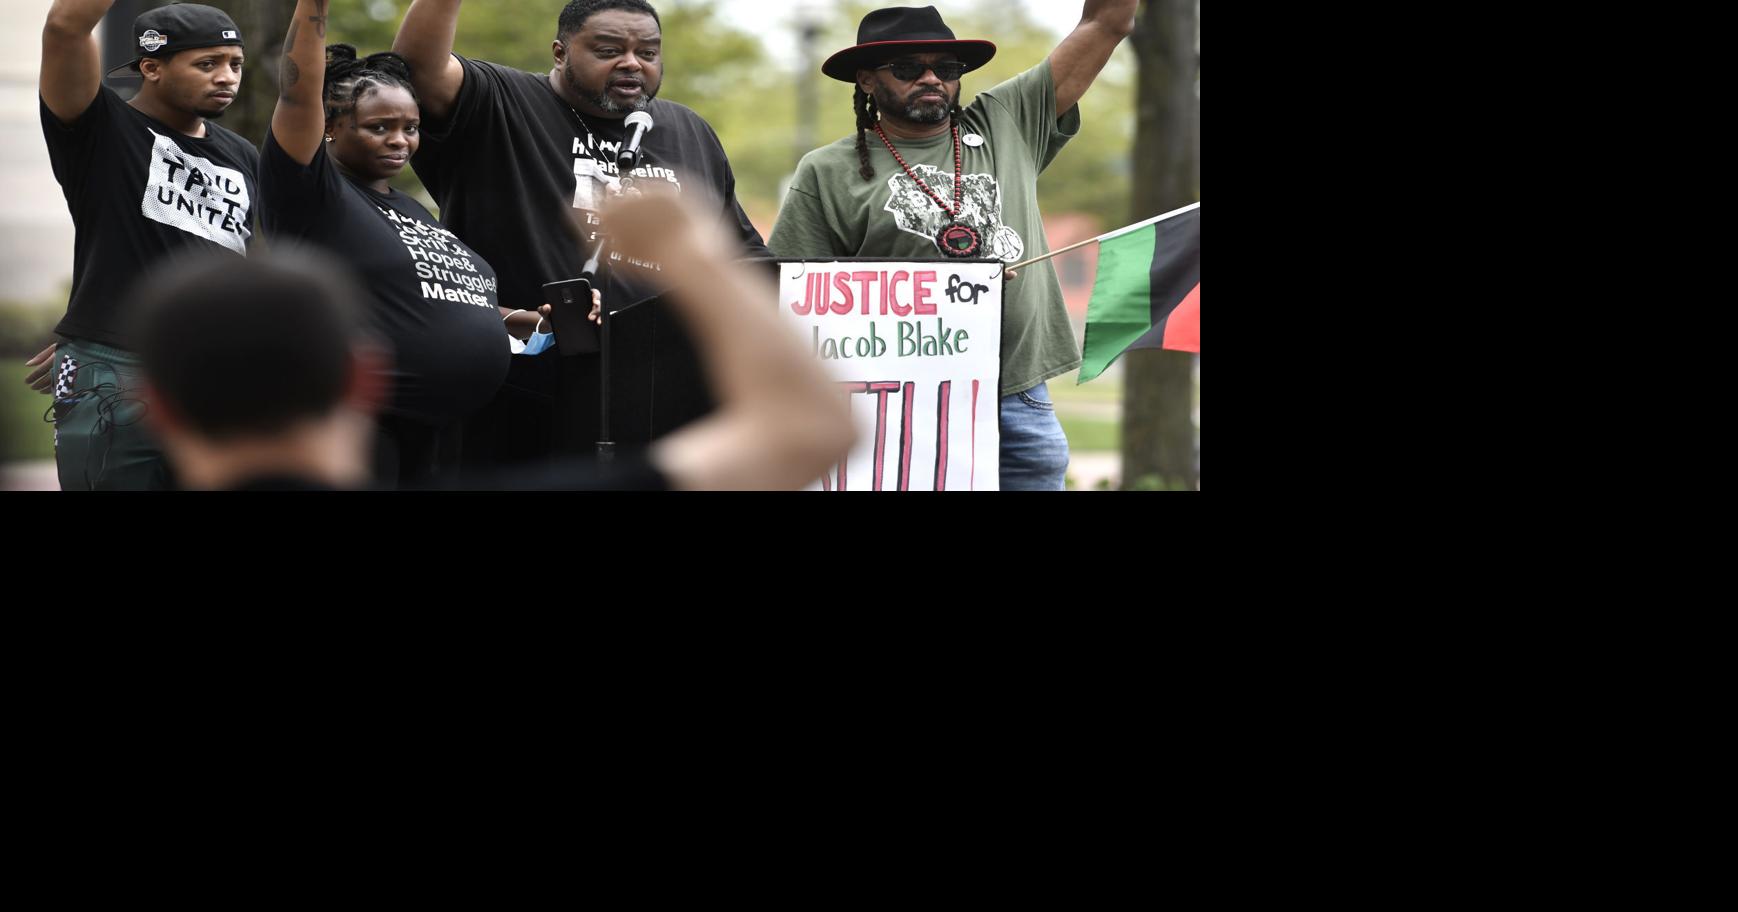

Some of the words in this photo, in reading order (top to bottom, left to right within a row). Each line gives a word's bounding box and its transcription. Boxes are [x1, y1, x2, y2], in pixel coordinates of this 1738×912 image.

[406, 245, 478, 273] Hope&
[420, 281, 495, 309] Matter.
[790, 270, 938, 317] JUSTICE
[945, 273, 989, 305] for
[897, 317, 969, 358] Blake
